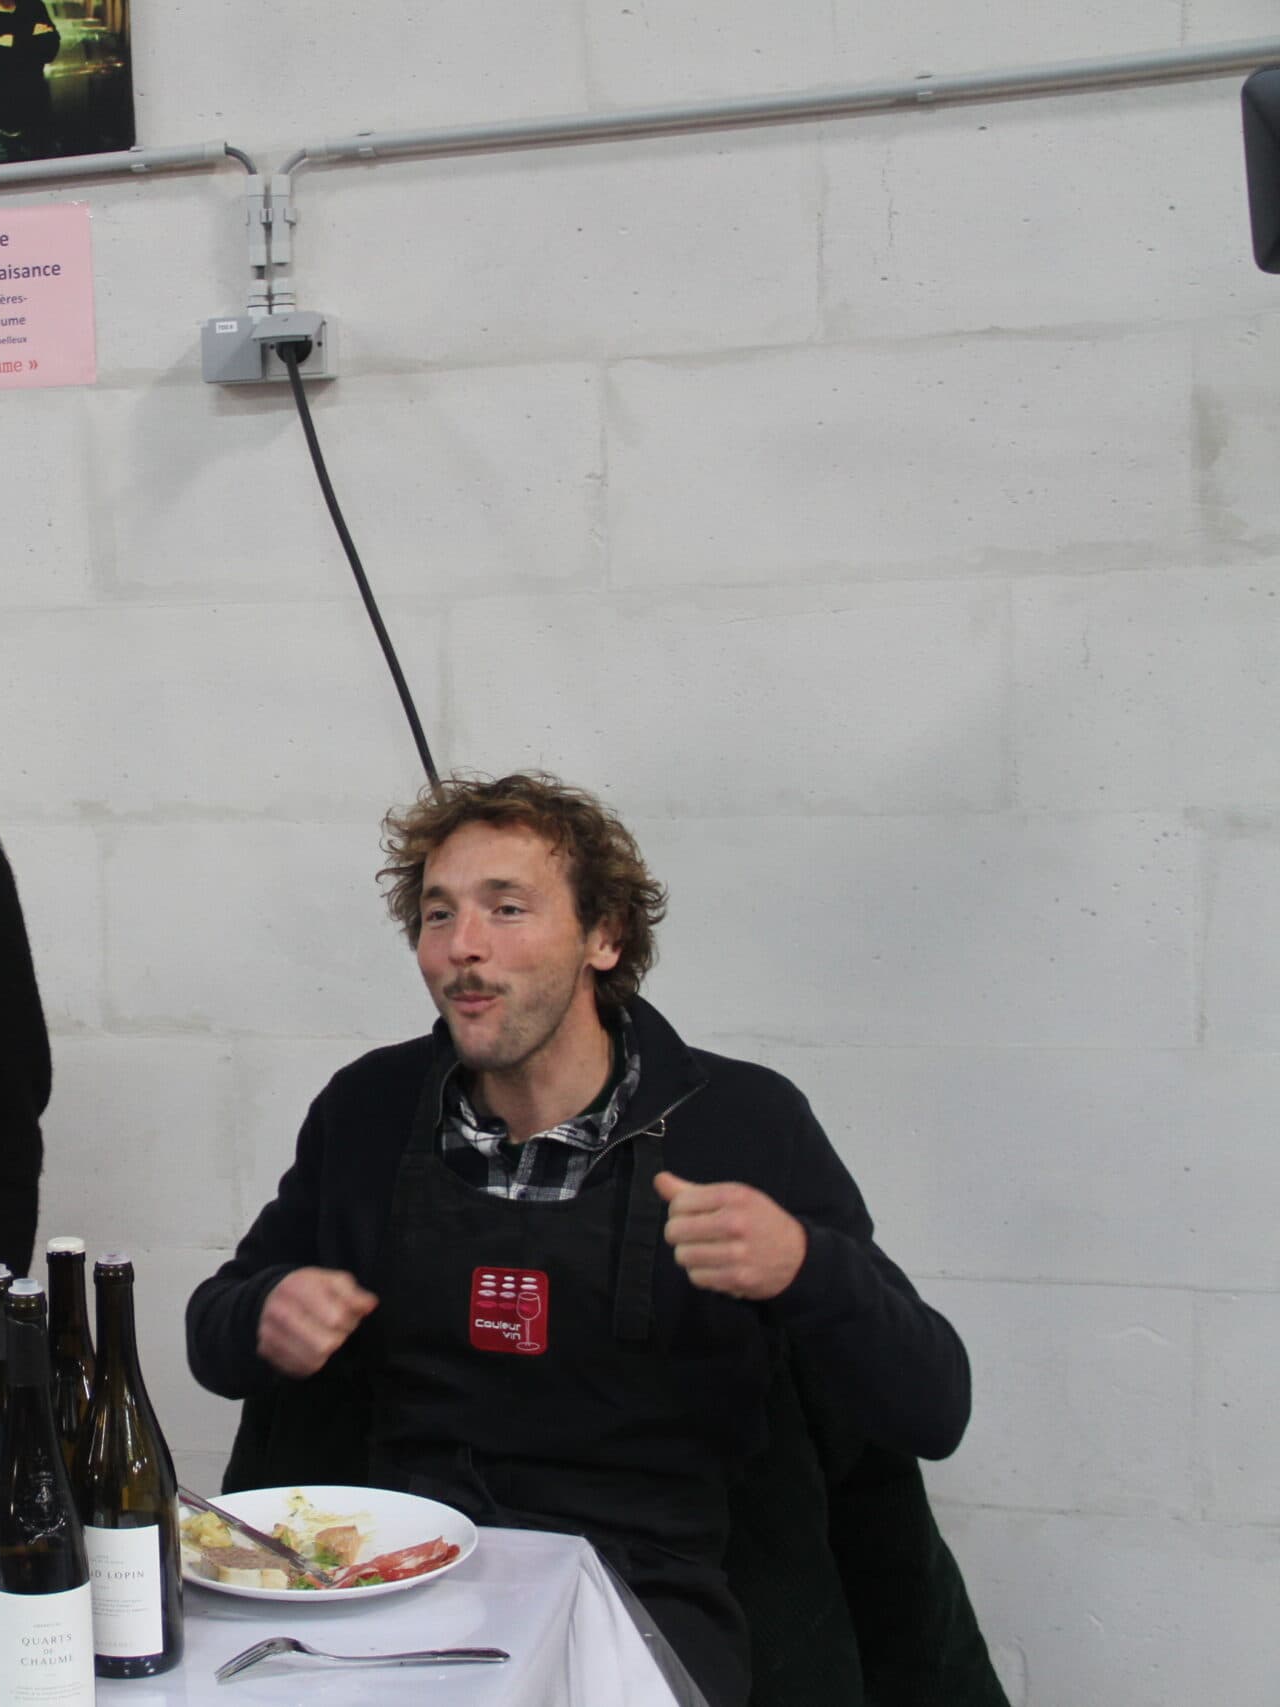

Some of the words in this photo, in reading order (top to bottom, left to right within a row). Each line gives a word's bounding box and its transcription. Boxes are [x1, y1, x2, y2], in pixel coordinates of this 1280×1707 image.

[475, 1318, 522, 1331] Couleur
[503, 1331, 521, 1340] vin
[107, 1569, 145, 1579] LOPIN
[21, 1633, 72, 1647] QUARTS
